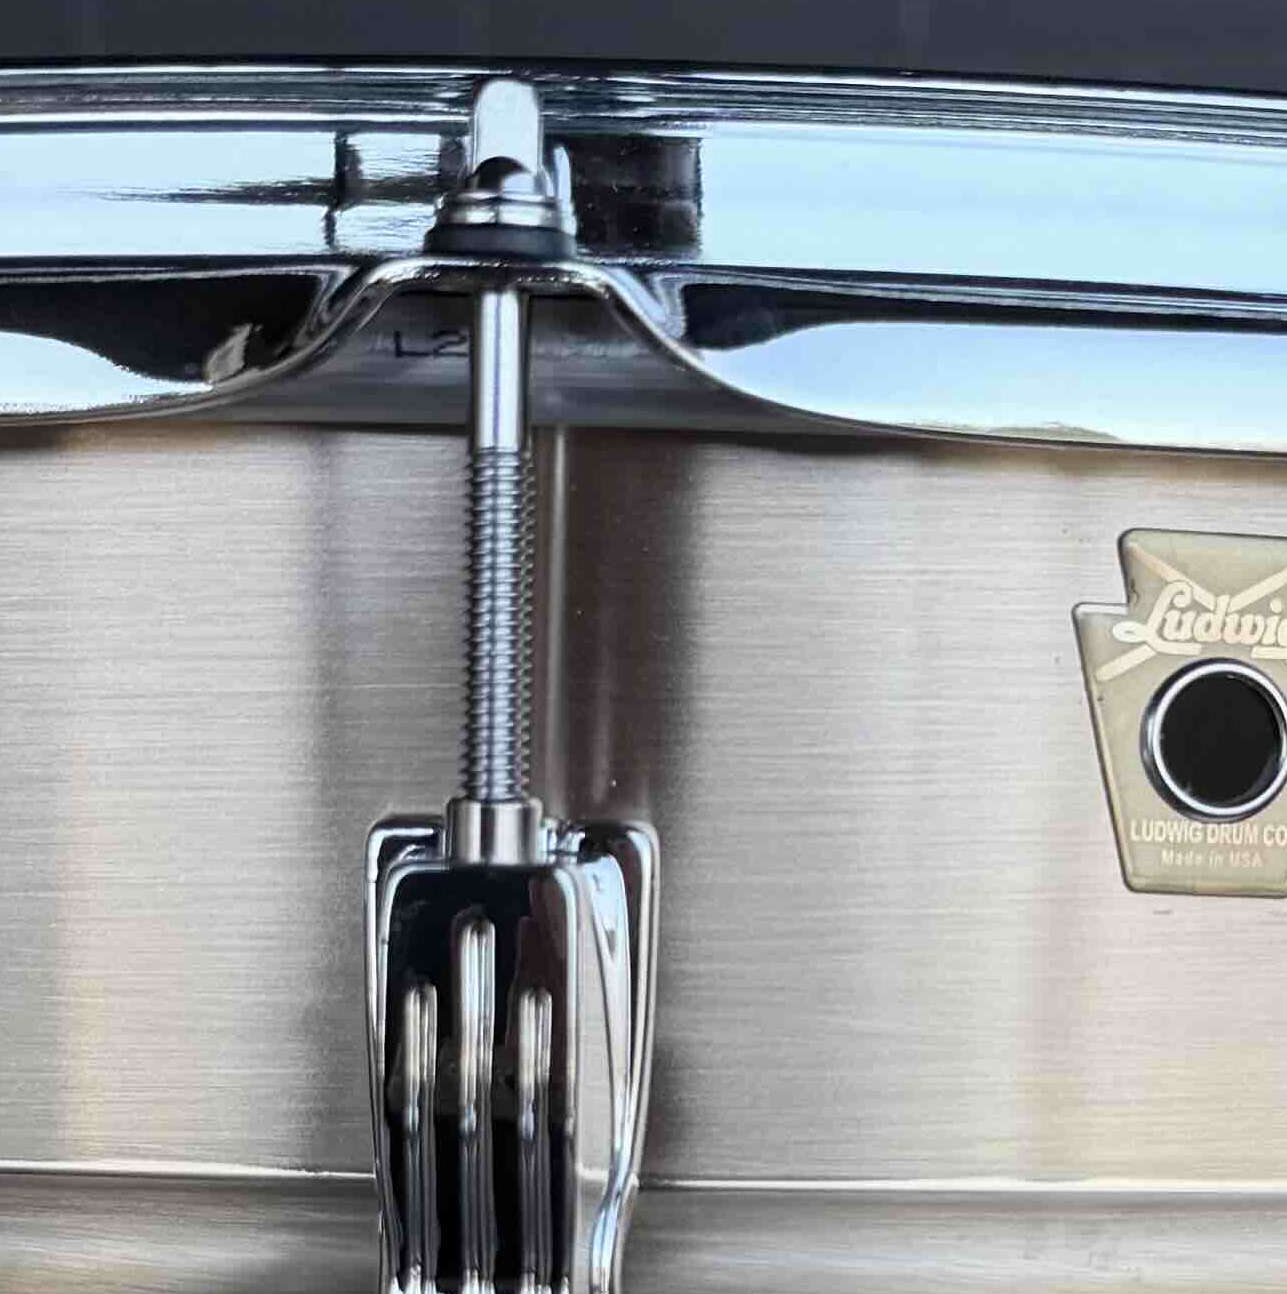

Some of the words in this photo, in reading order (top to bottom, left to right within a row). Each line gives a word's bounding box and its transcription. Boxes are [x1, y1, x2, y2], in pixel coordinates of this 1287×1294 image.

[1130, 819, 1202, 844] LUDWIG
[1207, 823, 1258, 845] DRUM
[1162, 850, 1201, 866] Made
[1230, 851, 1264, 868] USA
